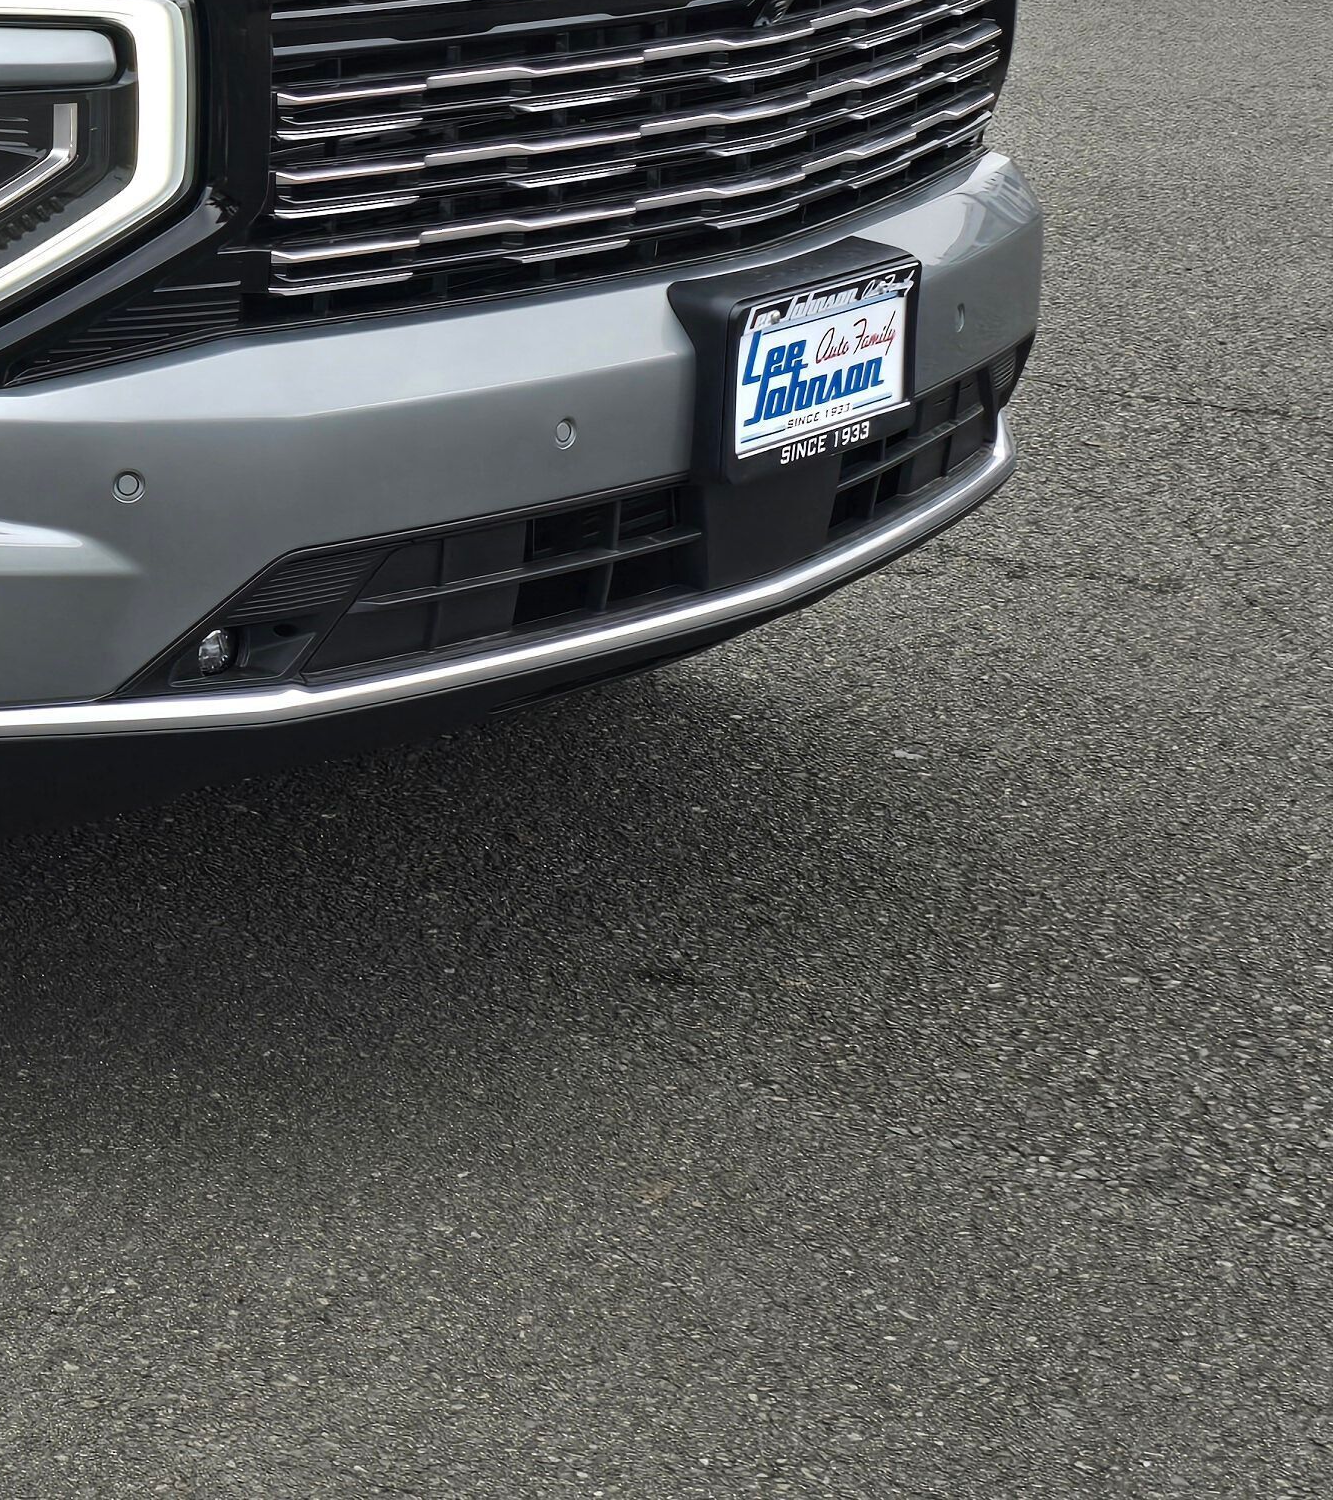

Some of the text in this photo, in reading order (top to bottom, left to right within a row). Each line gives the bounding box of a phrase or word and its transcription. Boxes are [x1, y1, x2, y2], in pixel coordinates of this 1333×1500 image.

[741, 310, 897, 386] Lee Auto Family
[743, 357, 886, 428] Johnson
[787, 411, 821, 430] SINCE
[779, 420, 871, 466] SINCE 1933
